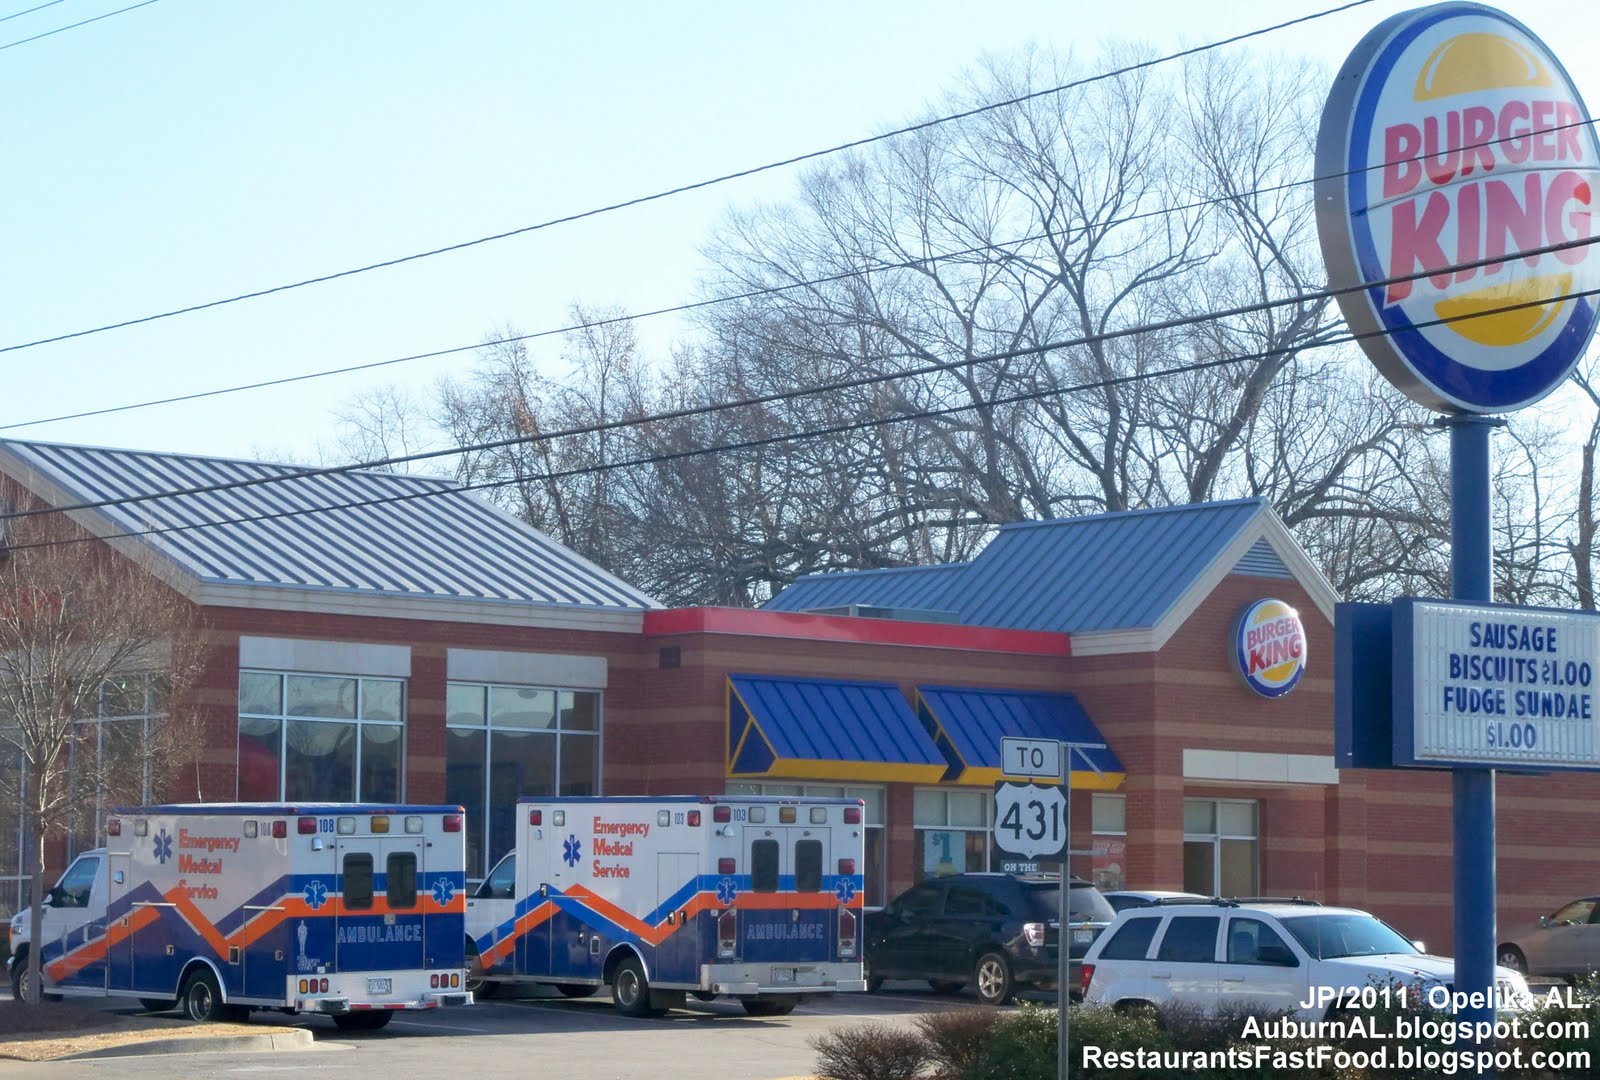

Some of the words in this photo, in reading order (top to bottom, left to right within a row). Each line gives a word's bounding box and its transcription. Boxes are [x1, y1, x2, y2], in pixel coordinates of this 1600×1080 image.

[1383, 100, 1583, 199] BURGER
[1384, 171, 1592, 308] KING
[1247, 618, 1300, 650] BURGER
[1470, 622, 1557, 652] SAUSAGE
[1248, 634, 1302, 676] KING
[1449, 653, 1538, 684] BISCUITS
[1541, 660, 1592, 687] $1.00
[1443, 686, 1506, 715] FUDGE
[1515, 690, 1592, 719] SUNDAE
[1487, 722, 1537, 749] $1.00
[1016, 746, 1044, 769] TO
[319, 818, 334, 833] 108
[674, 812, 684, 825] 103
[733, 808, 746, 821] 103
[1000, 800, 1059, 842] 431
[260, 822, 271, 836] 108
[593, 816, 650, 838] Emergency
[178, 828, 241, 853] Emergency
[592, 838, 633, 856] Medical
[178, 854, 222, 874] Medical
[592, 859, 630, 878] Service
[1004, 863, 1017, 872] ON
[1019, 863, 1037, 872] THE
[177, 879, 218, 900] Service
[337, 924, 422, 943] AMBULANCE
[747, 923, 824, 940] AMBULANCE
